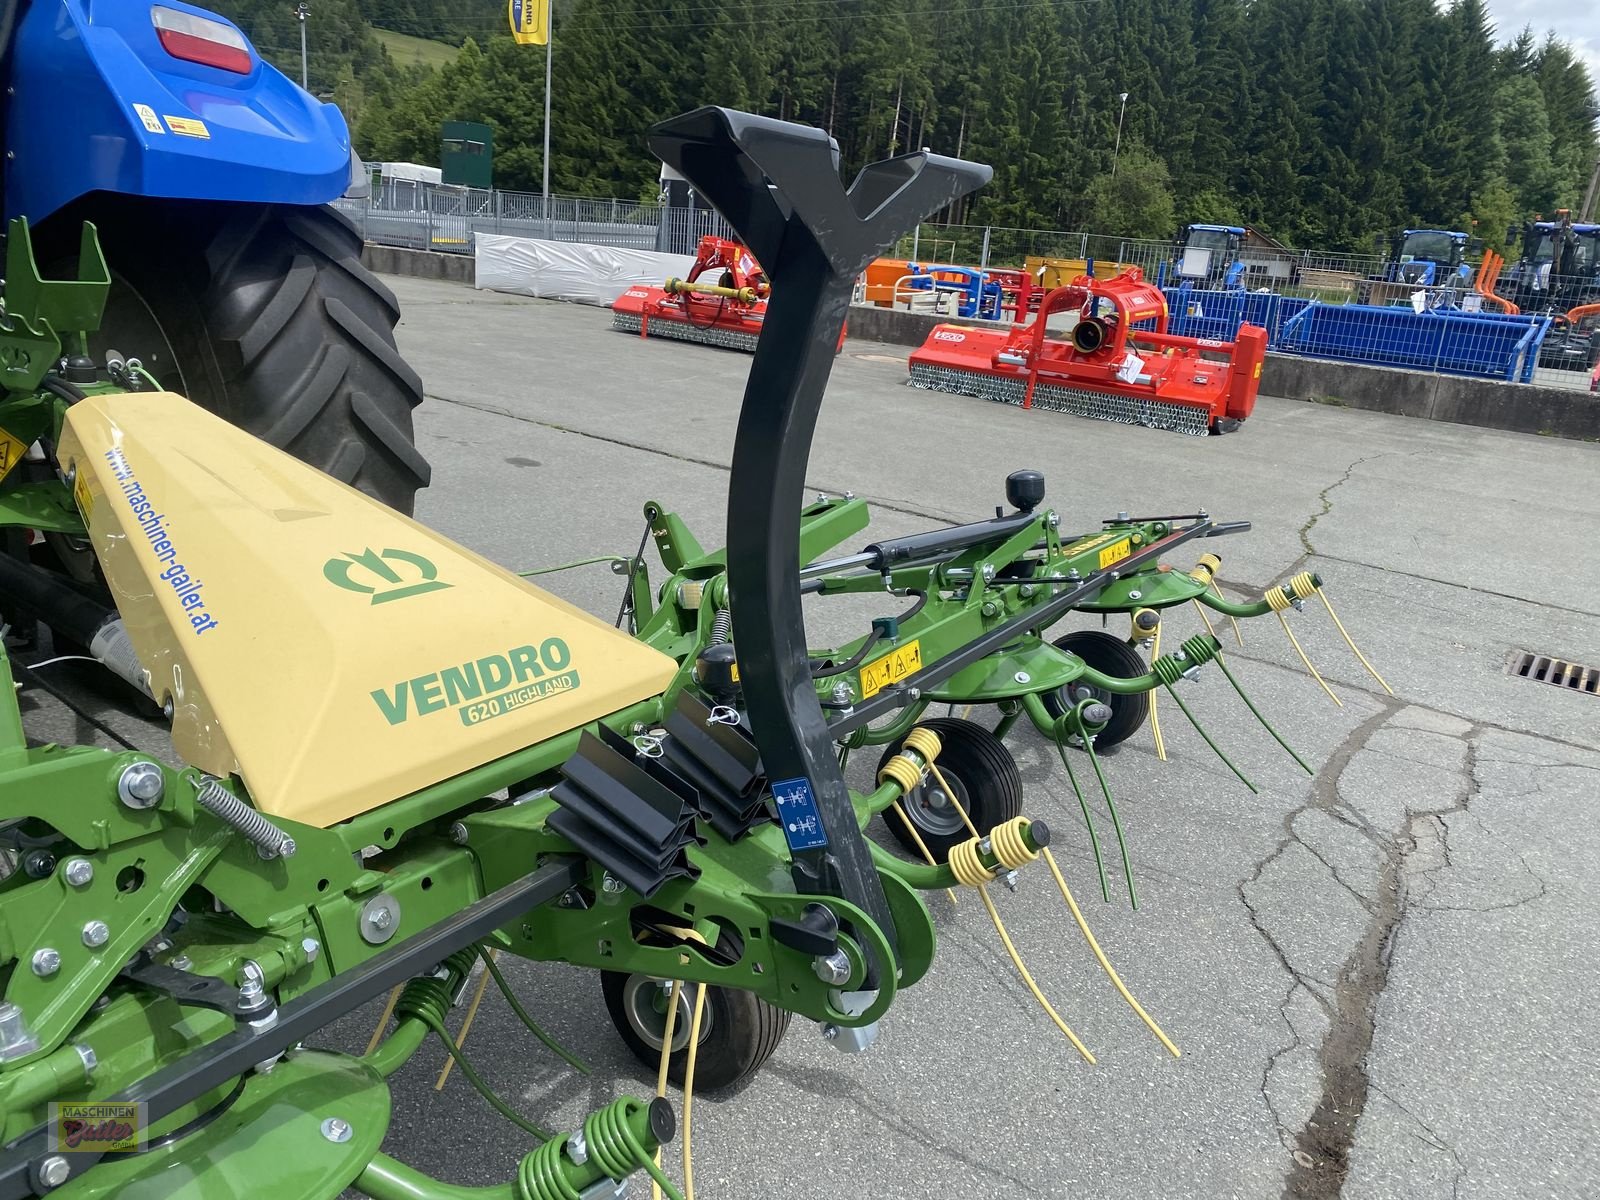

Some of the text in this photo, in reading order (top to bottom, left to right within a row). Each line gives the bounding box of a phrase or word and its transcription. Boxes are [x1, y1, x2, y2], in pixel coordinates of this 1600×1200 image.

[105, 447, 218, 635] www.maschinen-gailer.at
[371, 637, 571, 726] VENDRO
[467, 675, 572, 723] 620 HIGHLAND
